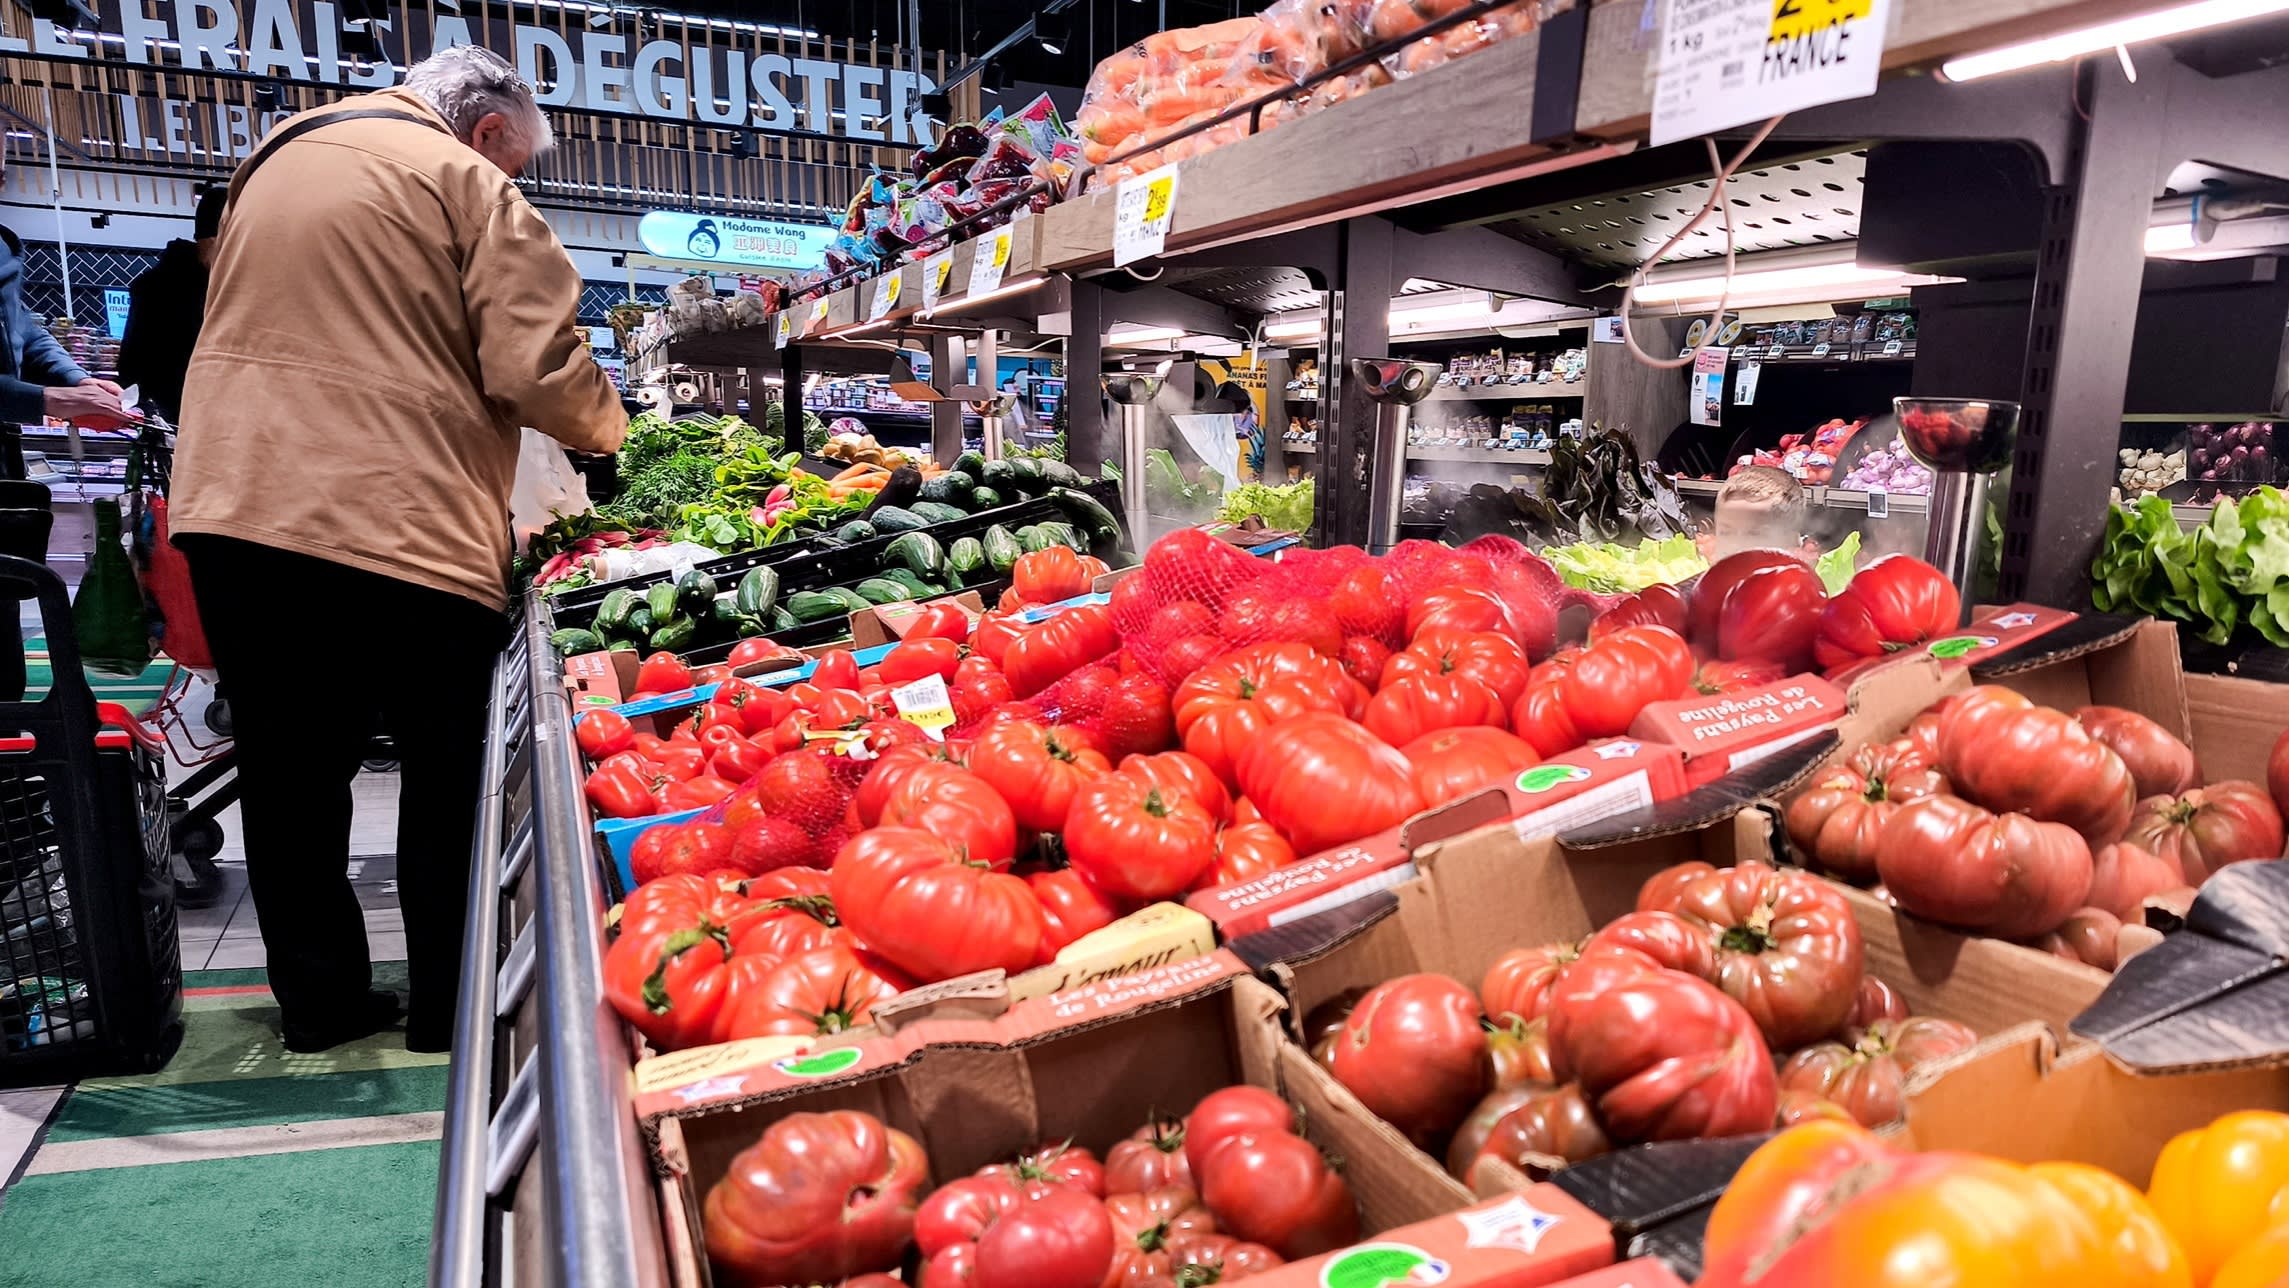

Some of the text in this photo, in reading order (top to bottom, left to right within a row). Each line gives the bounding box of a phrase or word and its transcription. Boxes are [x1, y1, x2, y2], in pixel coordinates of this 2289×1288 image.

[120, 0, 395, 87] FRAIS
[515, 13, 937, 146] DÉGUSTER
[1758, 13, 1855, 85] FRANCE
[120, 94, 198, 153] LE
[722, 221, 806, 241] Madame Wang
[1678, 686, 1806, 723] de Rougeline
[1692, 695, 1824, 742] Les Paysans
[1216, 858, 1332, 902] Rougeline
[1228, 869, 1328, 912] Paysans
[1050, 956, 1214, 1006] Les Paysans
[1055, 962, 1223, 1018] de Rougeline
